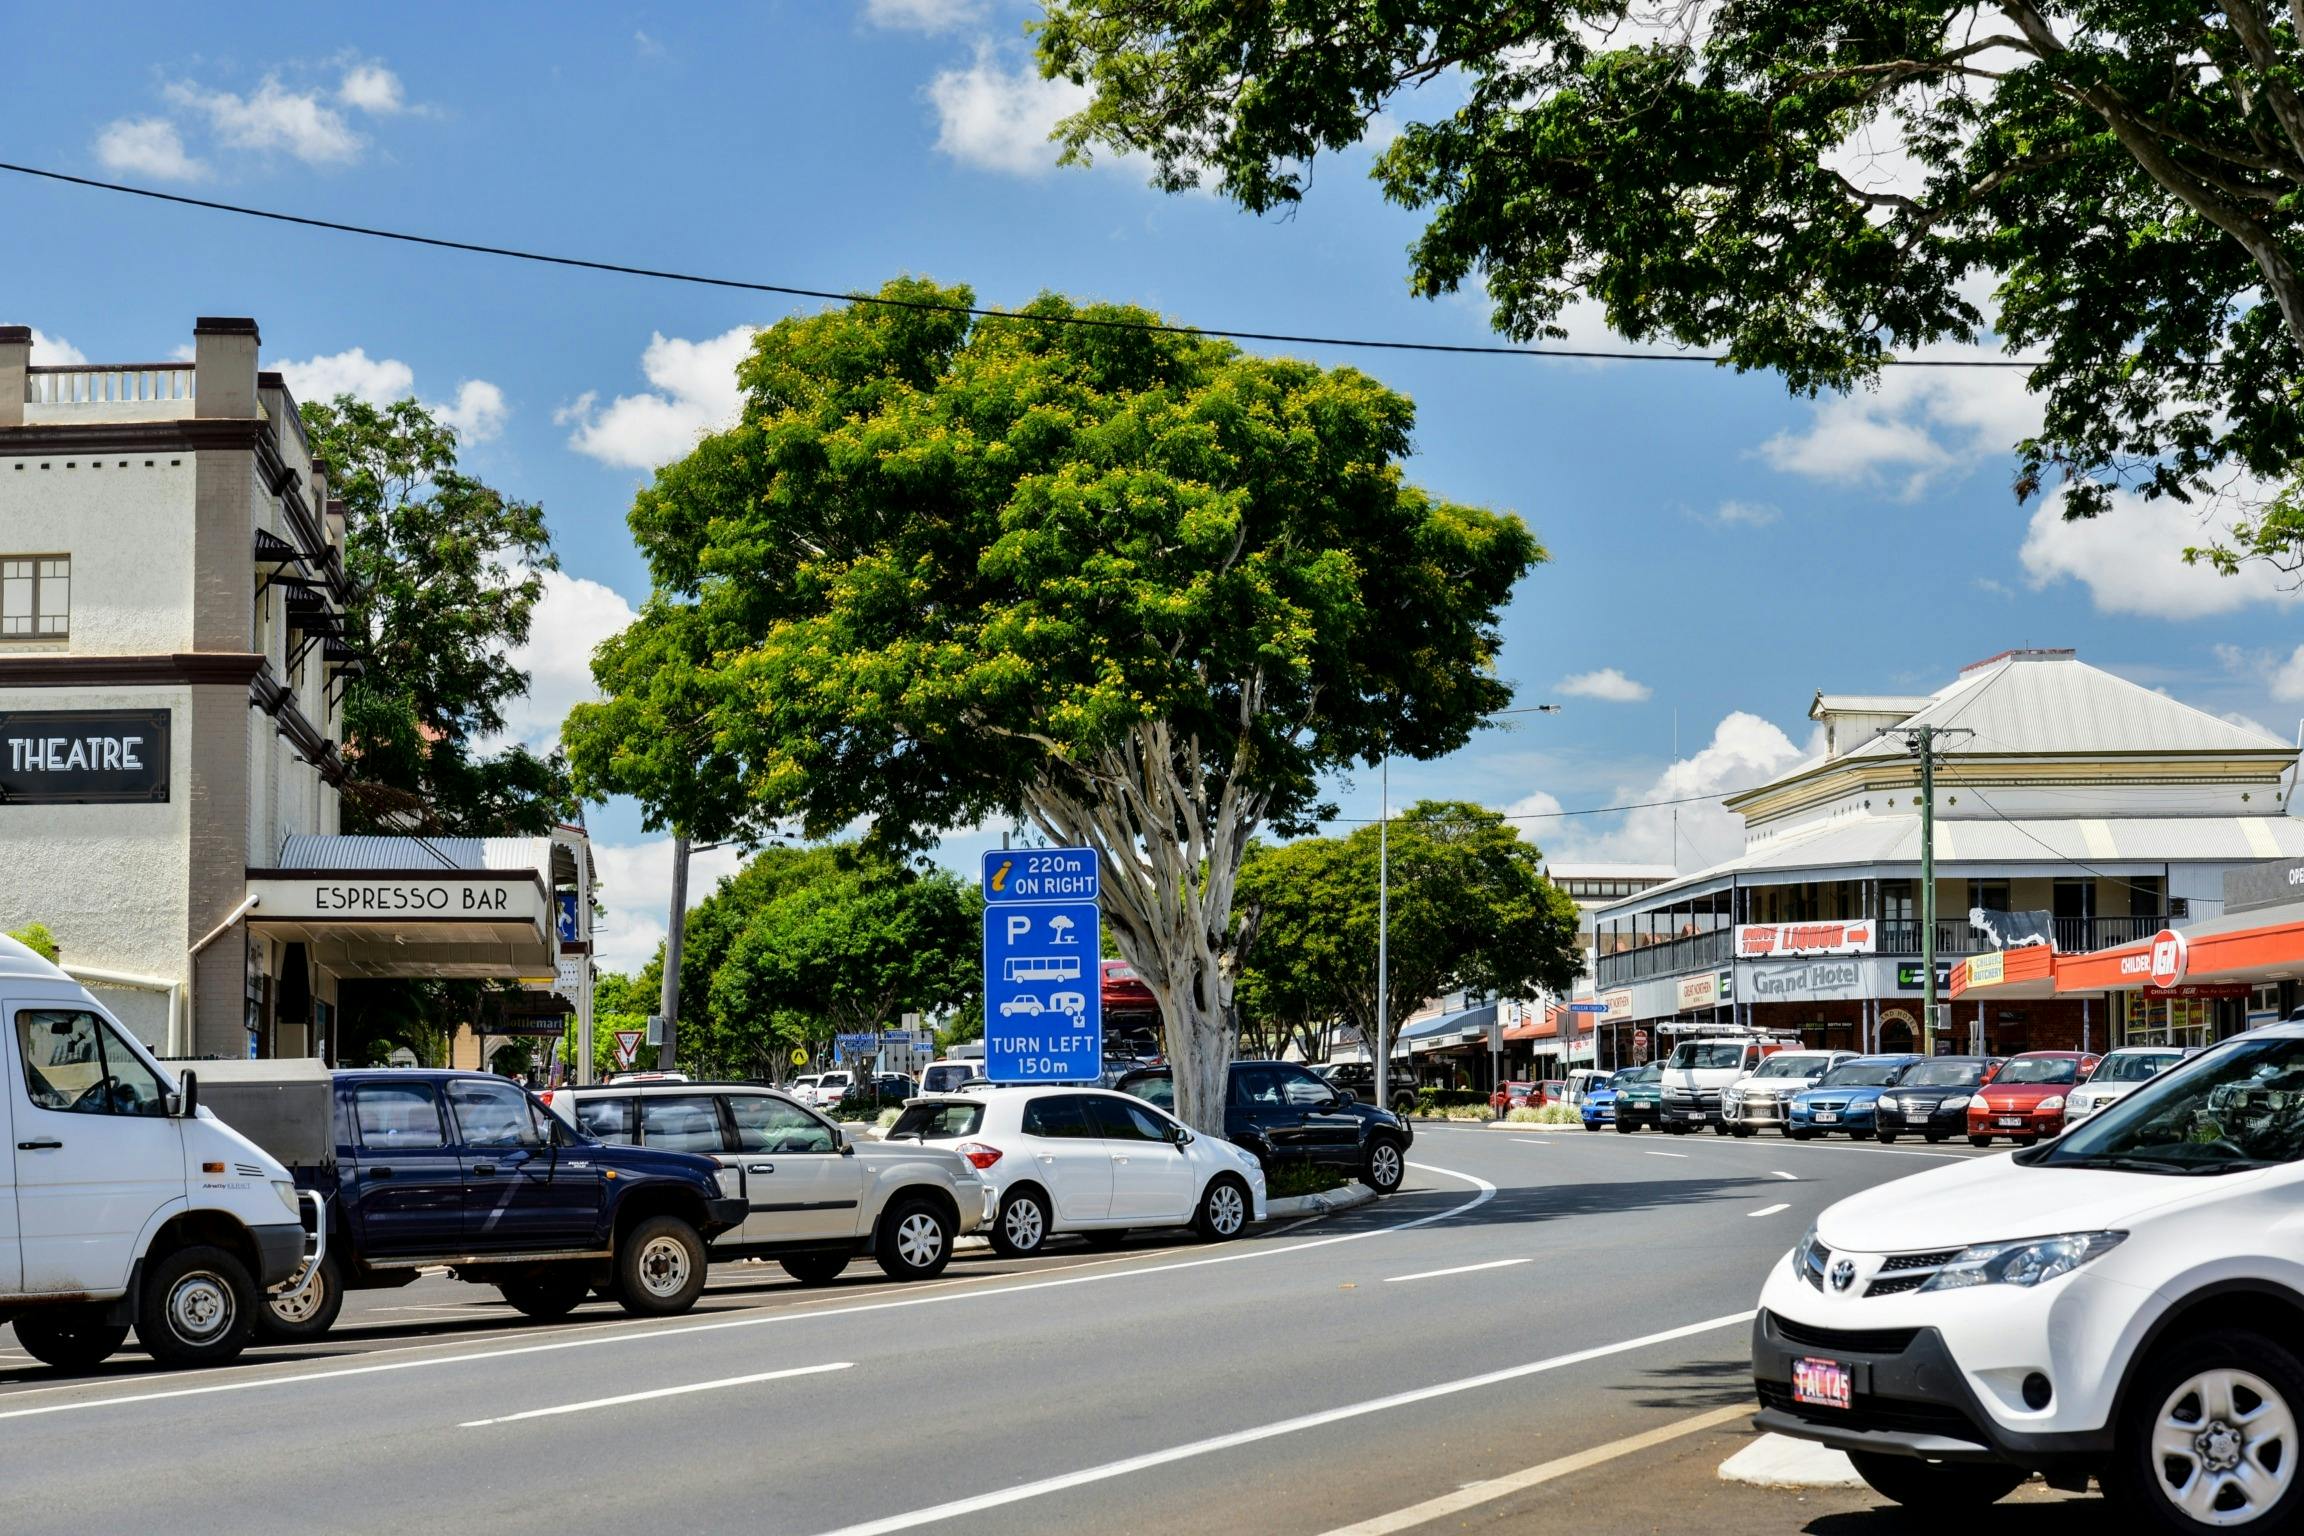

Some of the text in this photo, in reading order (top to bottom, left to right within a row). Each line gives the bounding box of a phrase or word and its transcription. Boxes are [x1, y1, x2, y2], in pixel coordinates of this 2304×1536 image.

[8, 736, 144, 772] THEATRE
[1028, 857, 1081, 873] 220m
[1015, 876, 1095, 895] ON RIGHT
[316, 887, 508, 909] ESPRESSO BAR
[1007, 916, 1032, 946] P
[1742, 925, 1845, 951] DRIVE LIQUOR
[2152, 940, 2178, 977] IGA
[1753, 968, 1808, 994] Grand
[1812, 963, 1860, 987] Hotel
[992, 1036, 1094, 1054] TURN LEFT
[1018, 1058, 1068, 1074] 150m
